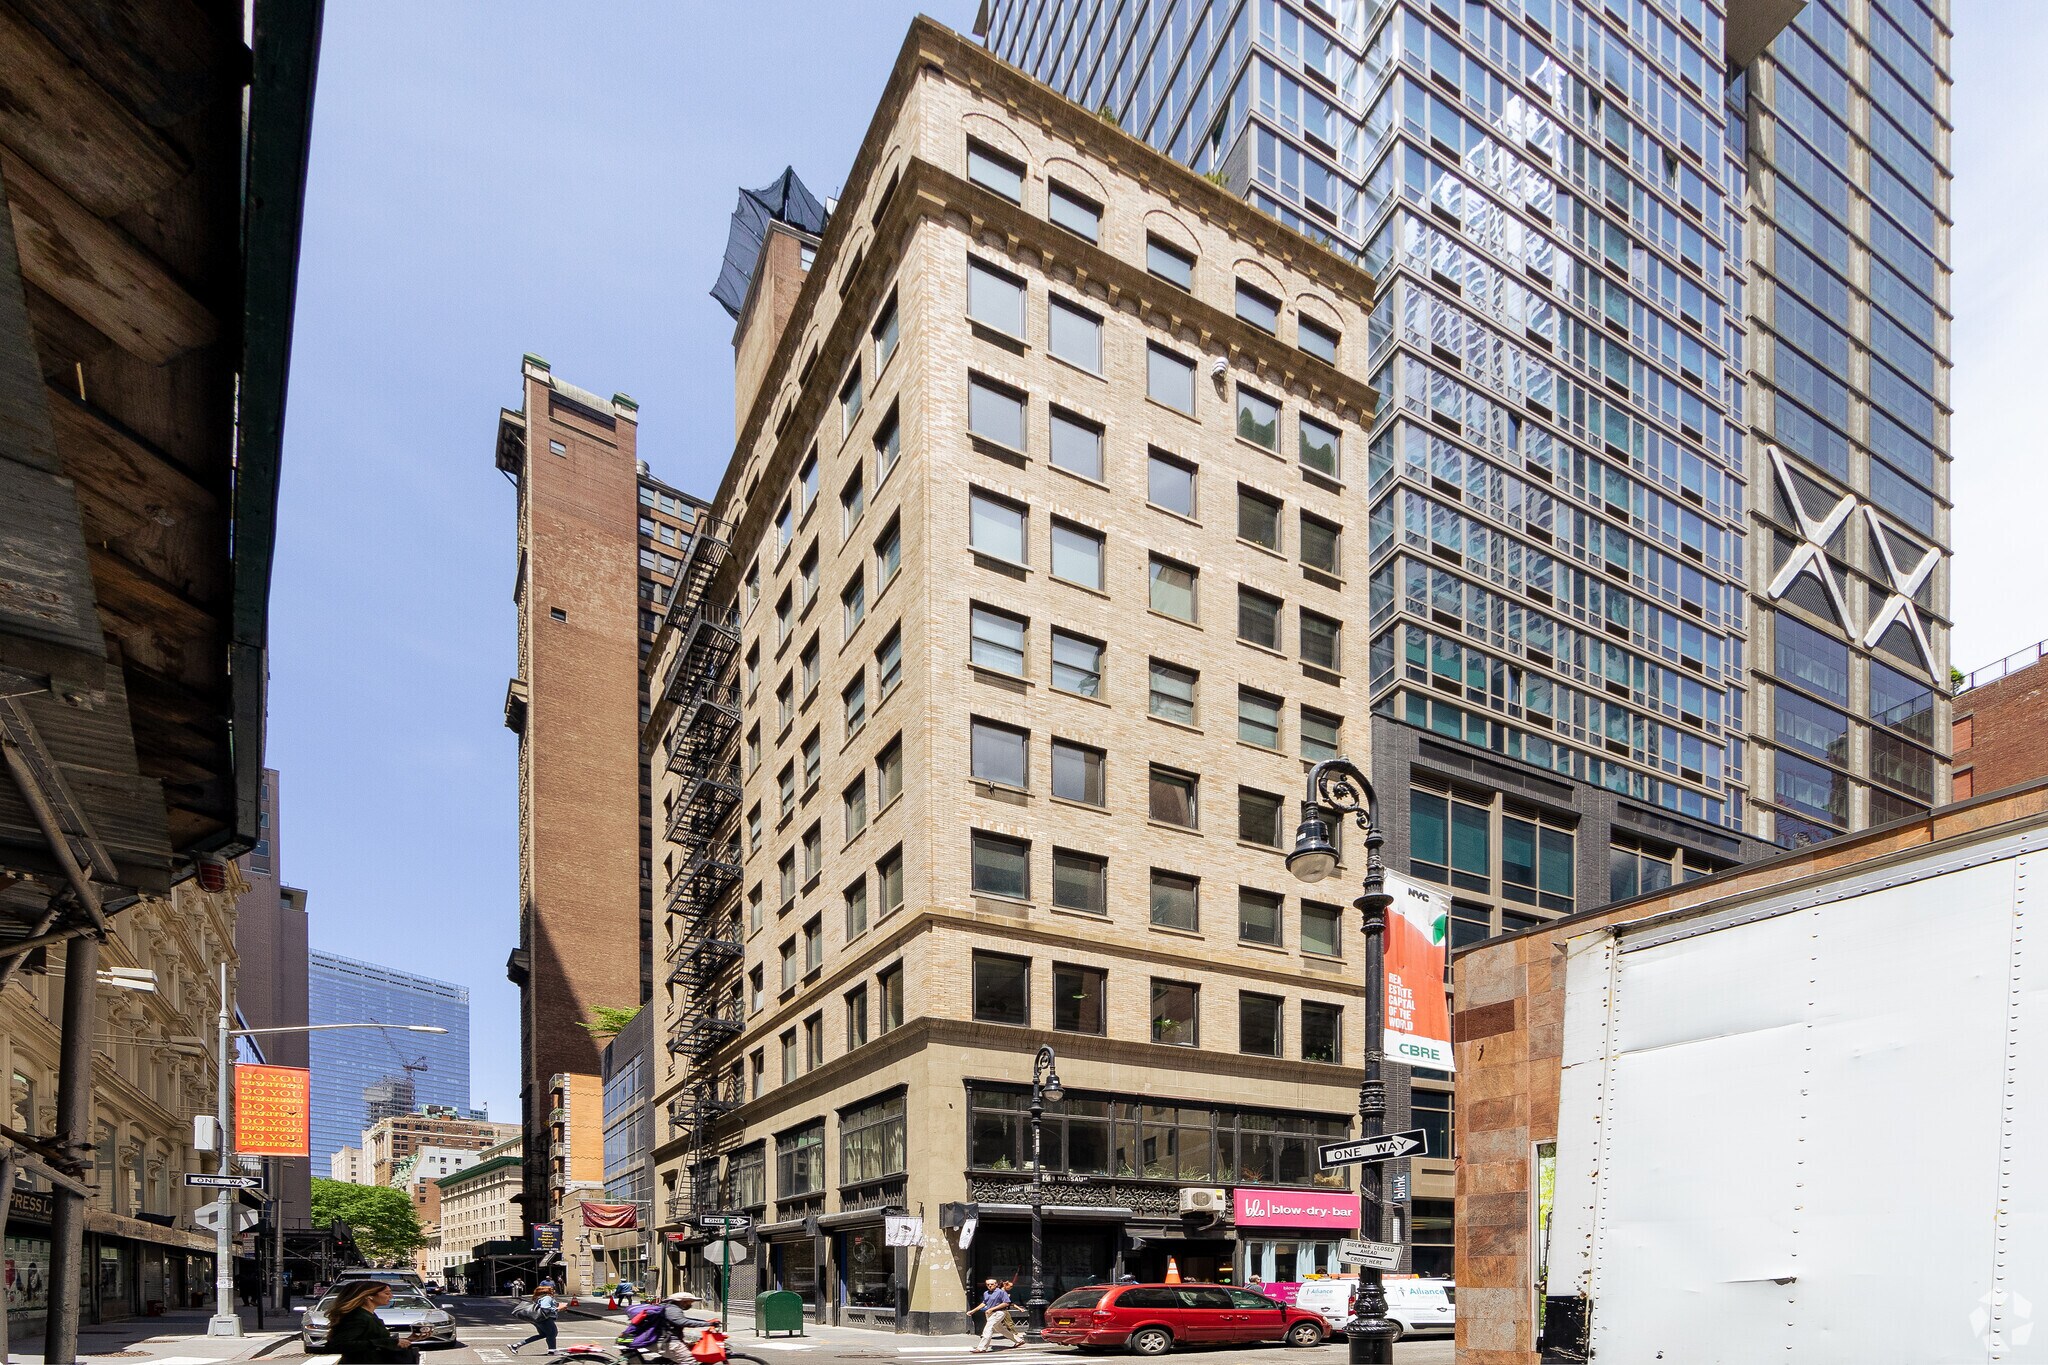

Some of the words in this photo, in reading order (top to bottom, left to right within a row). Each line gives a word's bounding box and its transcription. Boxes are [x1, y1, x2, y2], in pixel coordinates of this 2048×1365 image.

[1408, 888, 1429, 902] NYC
[1389, 995, 1416, 1010] CAPTAL
[1389, 1006, 1397, 1016] OF
[1389, 1016, 1413, 1031] WORLD
[1399, 1043, 1440, 1060] CBRE
[241, 1072, 264, 1080] DO
[269, 1075, 303, 1084] YOU
[269, 1090, 303, 1098] YOU
[269, 1105, 303, 1113] YOU
[269, 1134, 303, 1142] YOU
[1334, 1147, 1361, 1160] ONE
[1375, 1140, 1407, 1153] WAY
[1393, 1175, 1405, 1200] blink
[1245, 1199, 1265, 1216] blo
[1347, 1242, 1371, 1250] SIDEWALK
[1374, 1245, 1395, 1253] CLOSED
